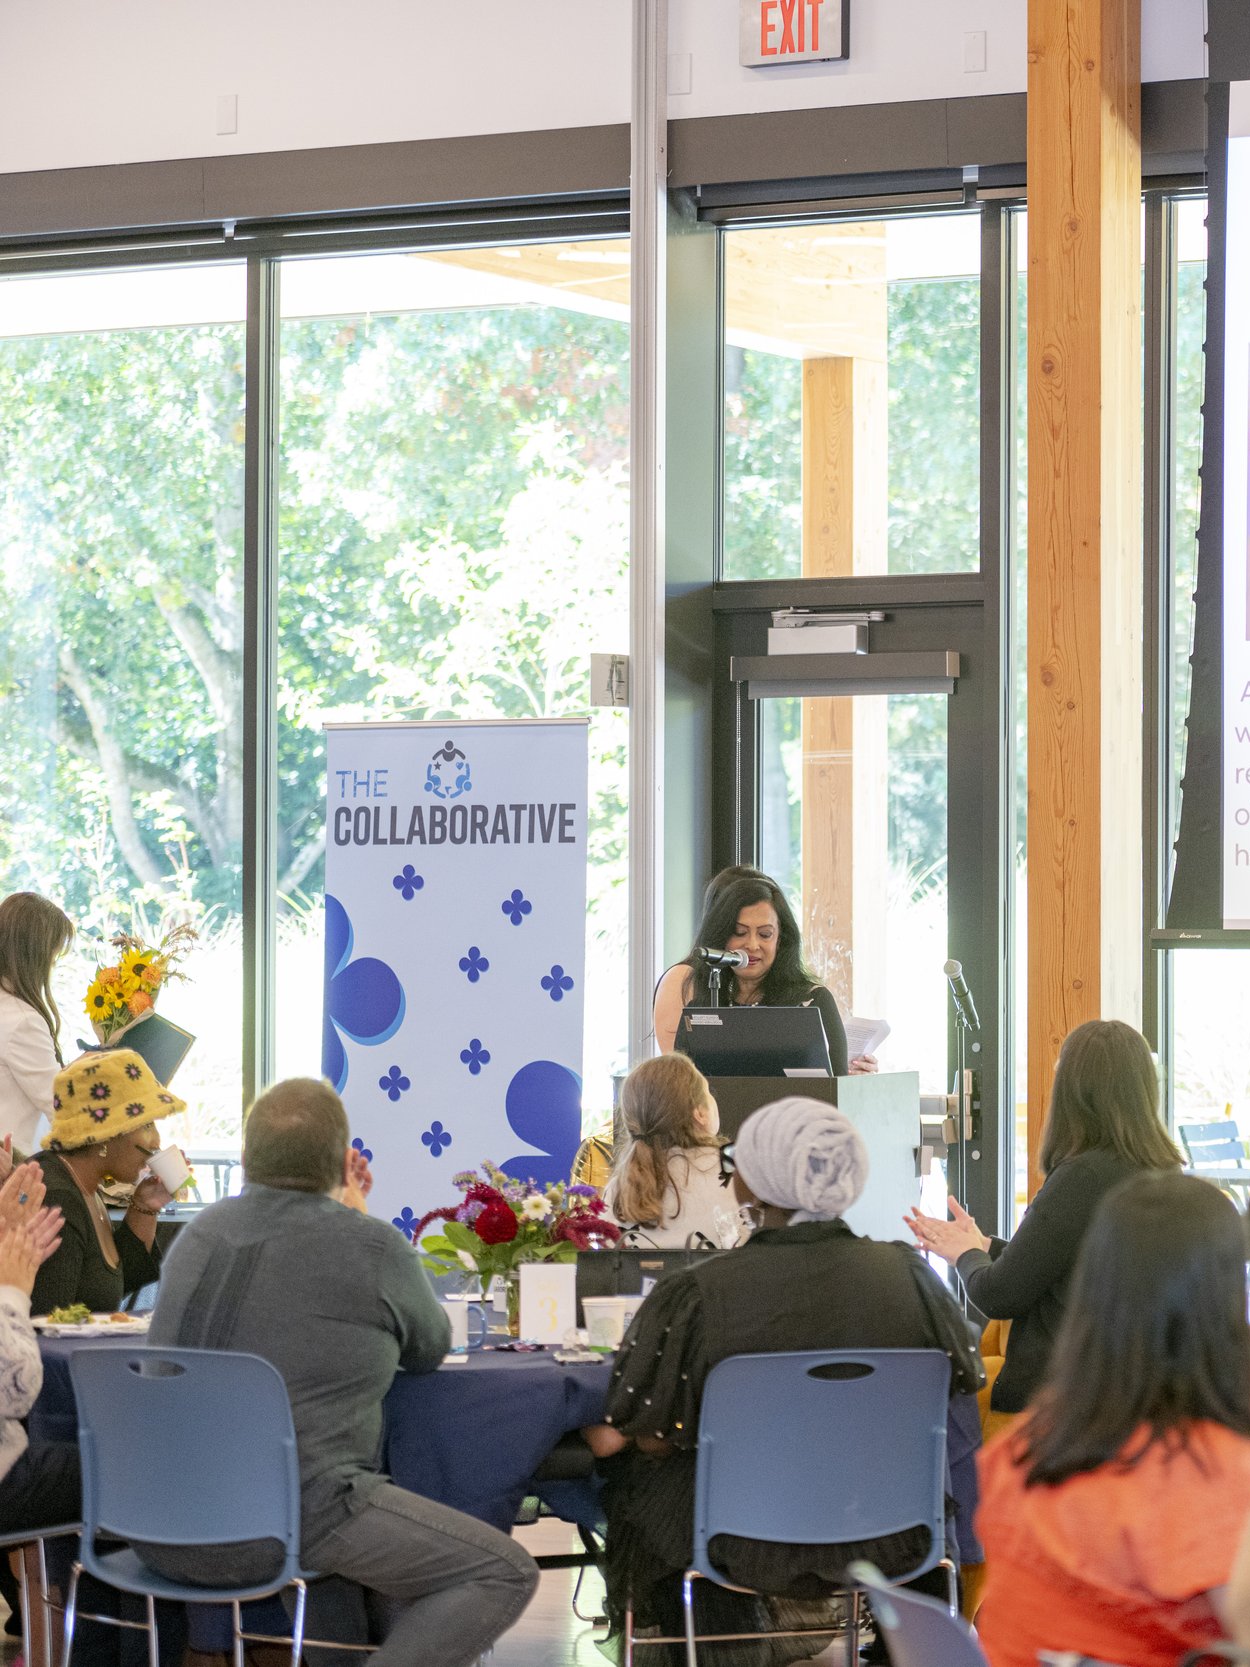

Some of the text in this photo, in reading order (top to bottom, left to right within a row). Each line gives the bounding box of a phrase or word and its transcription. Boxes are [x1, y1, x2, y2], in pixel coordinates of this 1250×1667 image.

[761, 0, 824, 56] EXIT
[336, 770, 388, 798] THE
[334, 803, 576, 847] COLLABORATIVE
